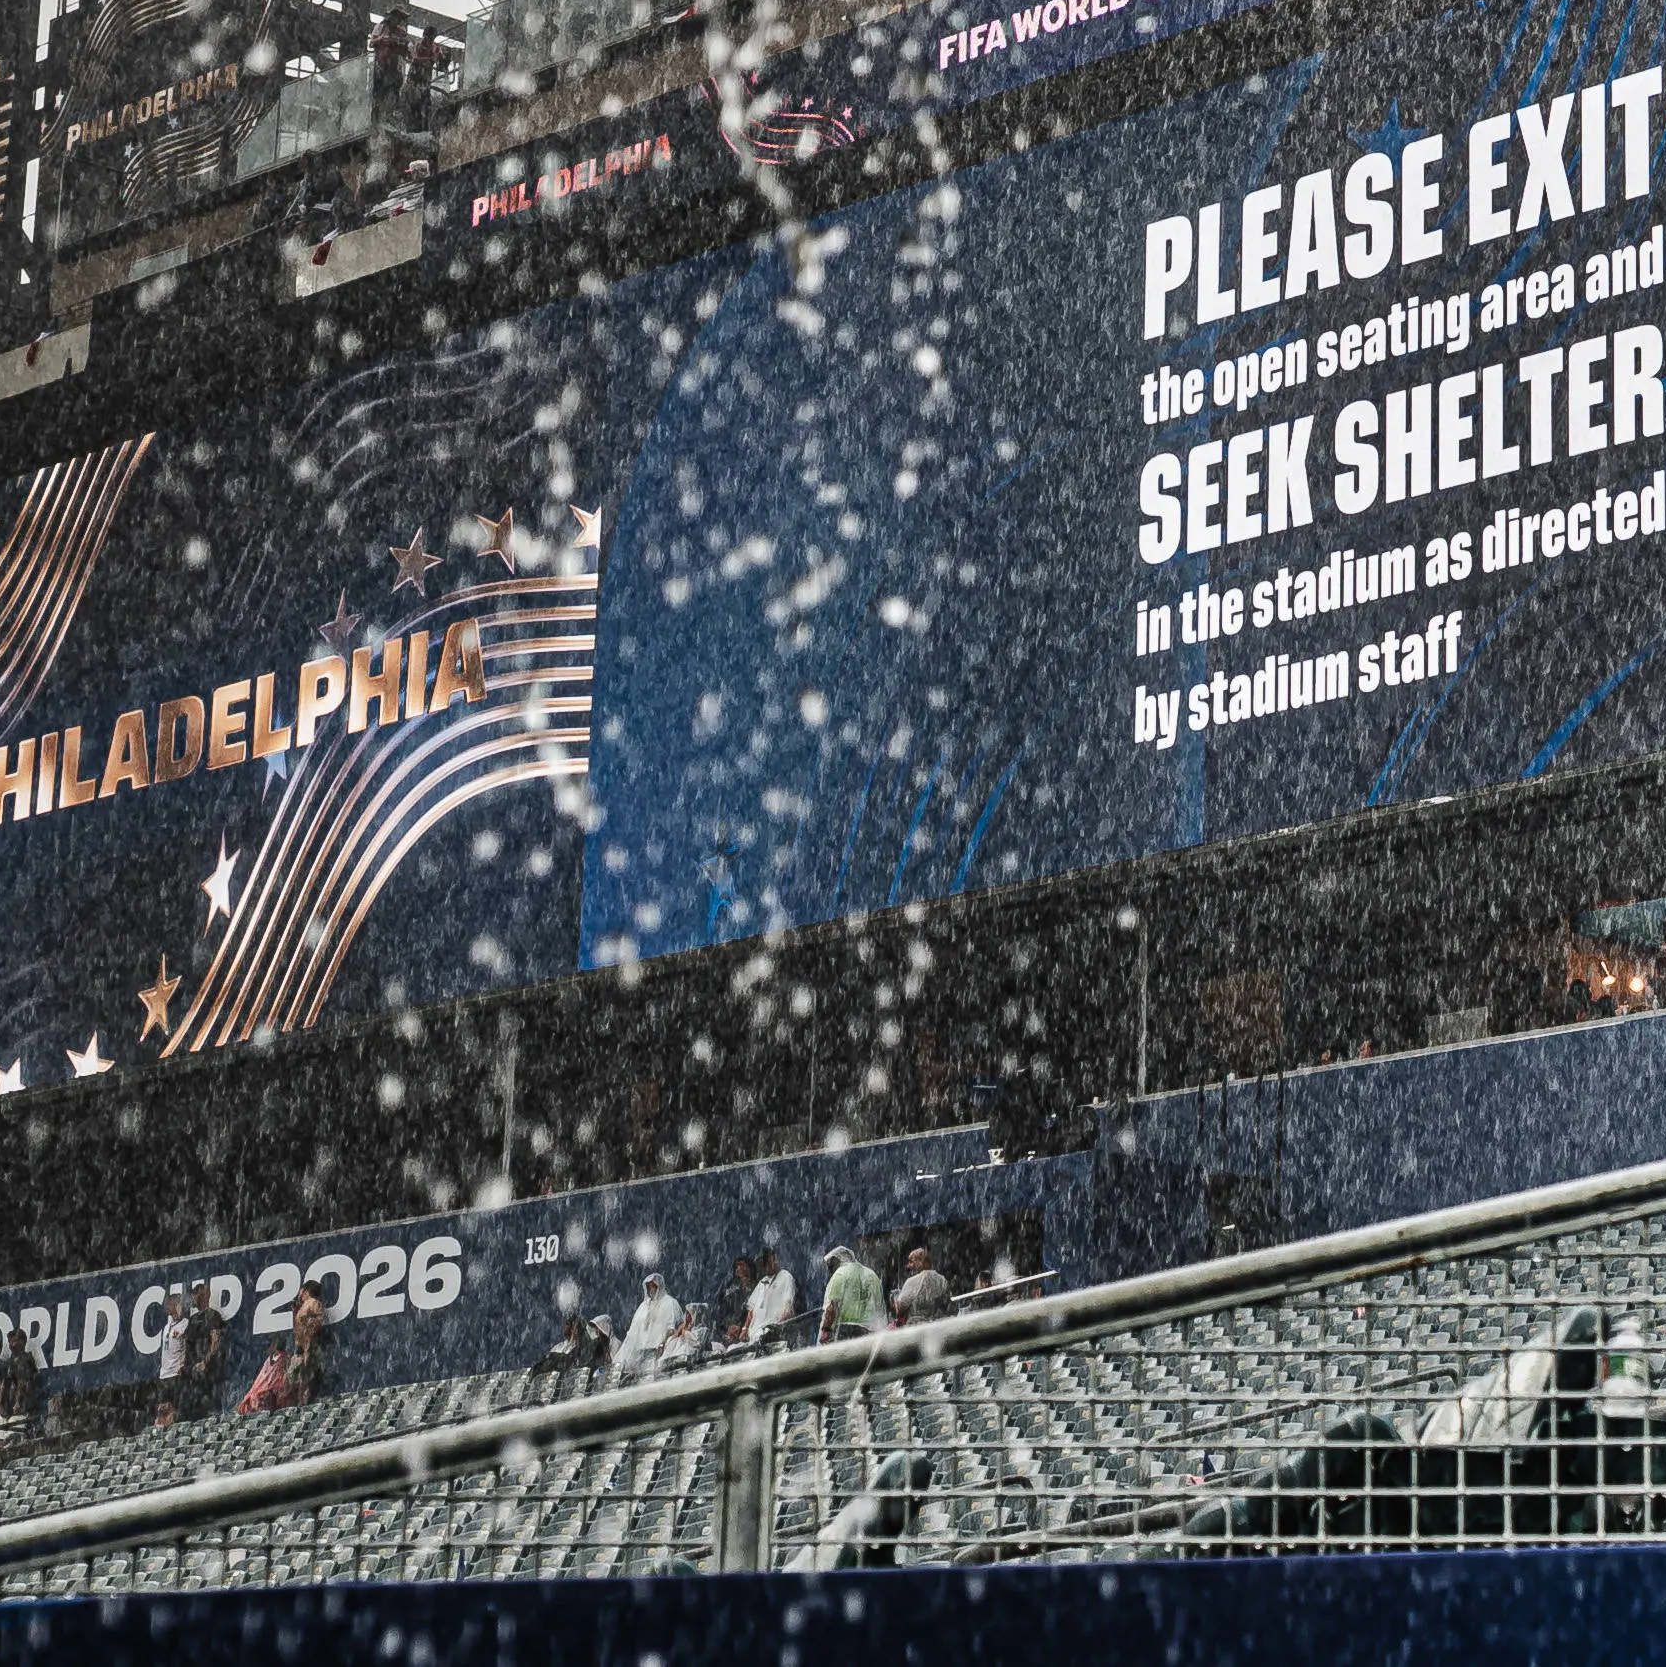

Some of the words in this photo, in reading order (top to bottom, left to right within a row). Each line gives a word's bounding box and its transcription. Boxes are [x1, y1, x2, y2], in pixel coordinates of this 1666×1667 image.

[66, 63, 239, 152] PHILADELPHIA
[939, 19, 1007, 70] FIFA
[1143, 134, 1445, 340] PLEASE
[1468, 66, 1664, 246] EXIT
[1140, 361, 1207, 427] the
[1212, 339, 1308, 413] open
[1316, 292, 1471, 377] seating
[1480, 269, 1575, 335] area
[1585, 226, 1665, 304] and
[1138, 416, 1316, 567] SEEK
[1333, 324, 1666, 517] SHELTER
[1136, 599, 1172, 657] in
[1179, 583, 1245, 642] the
[1252, 550, 1417, 623] stadium
[1424, 536, 1473, 587] as
[1481, 471, 1666, 577] directed
[1134, 687, 1180, 750] by
[1188, 648, 1351, 731] stadium
[1358, 612, 1464, 691] staff
[252, 1236, 462, 1335] 2026
[524, 1235, 559, 1265] 130
